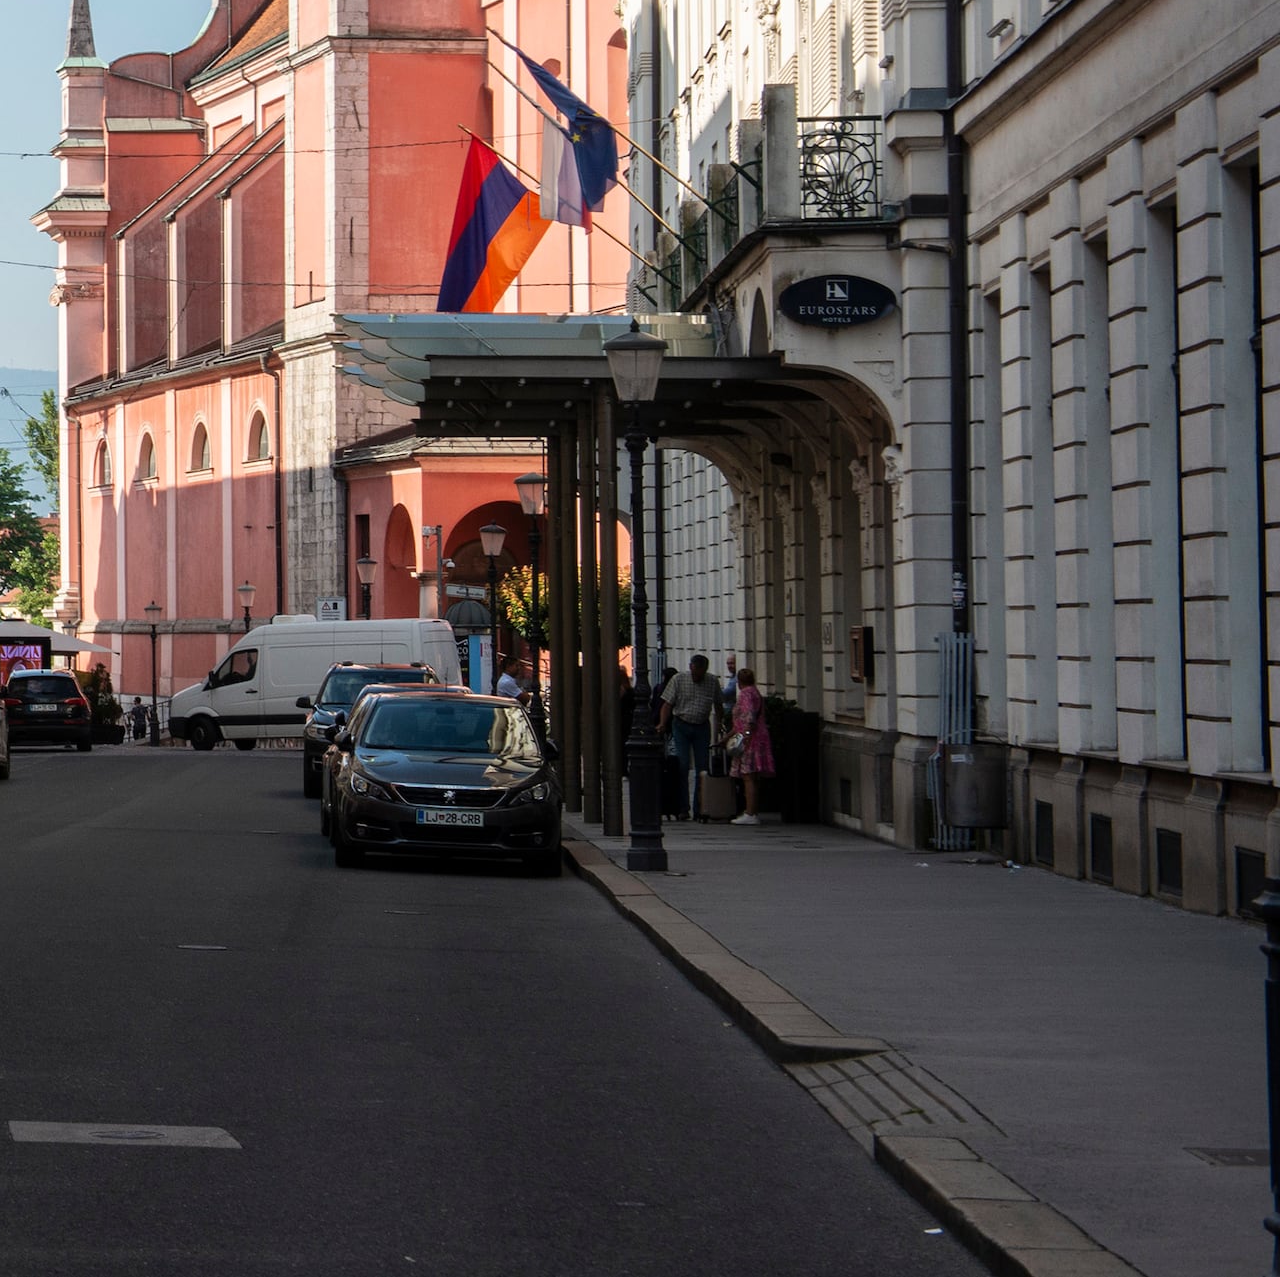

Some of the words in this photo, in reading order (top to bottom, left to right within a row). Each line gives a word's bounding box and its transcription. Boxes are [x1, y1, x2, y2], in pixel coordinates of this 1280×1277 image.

[799, 305, 877, 316] EUROSTARS
[426, 811, 438, 823] LJ
[445, 812, 481, 824] 28-CRB
